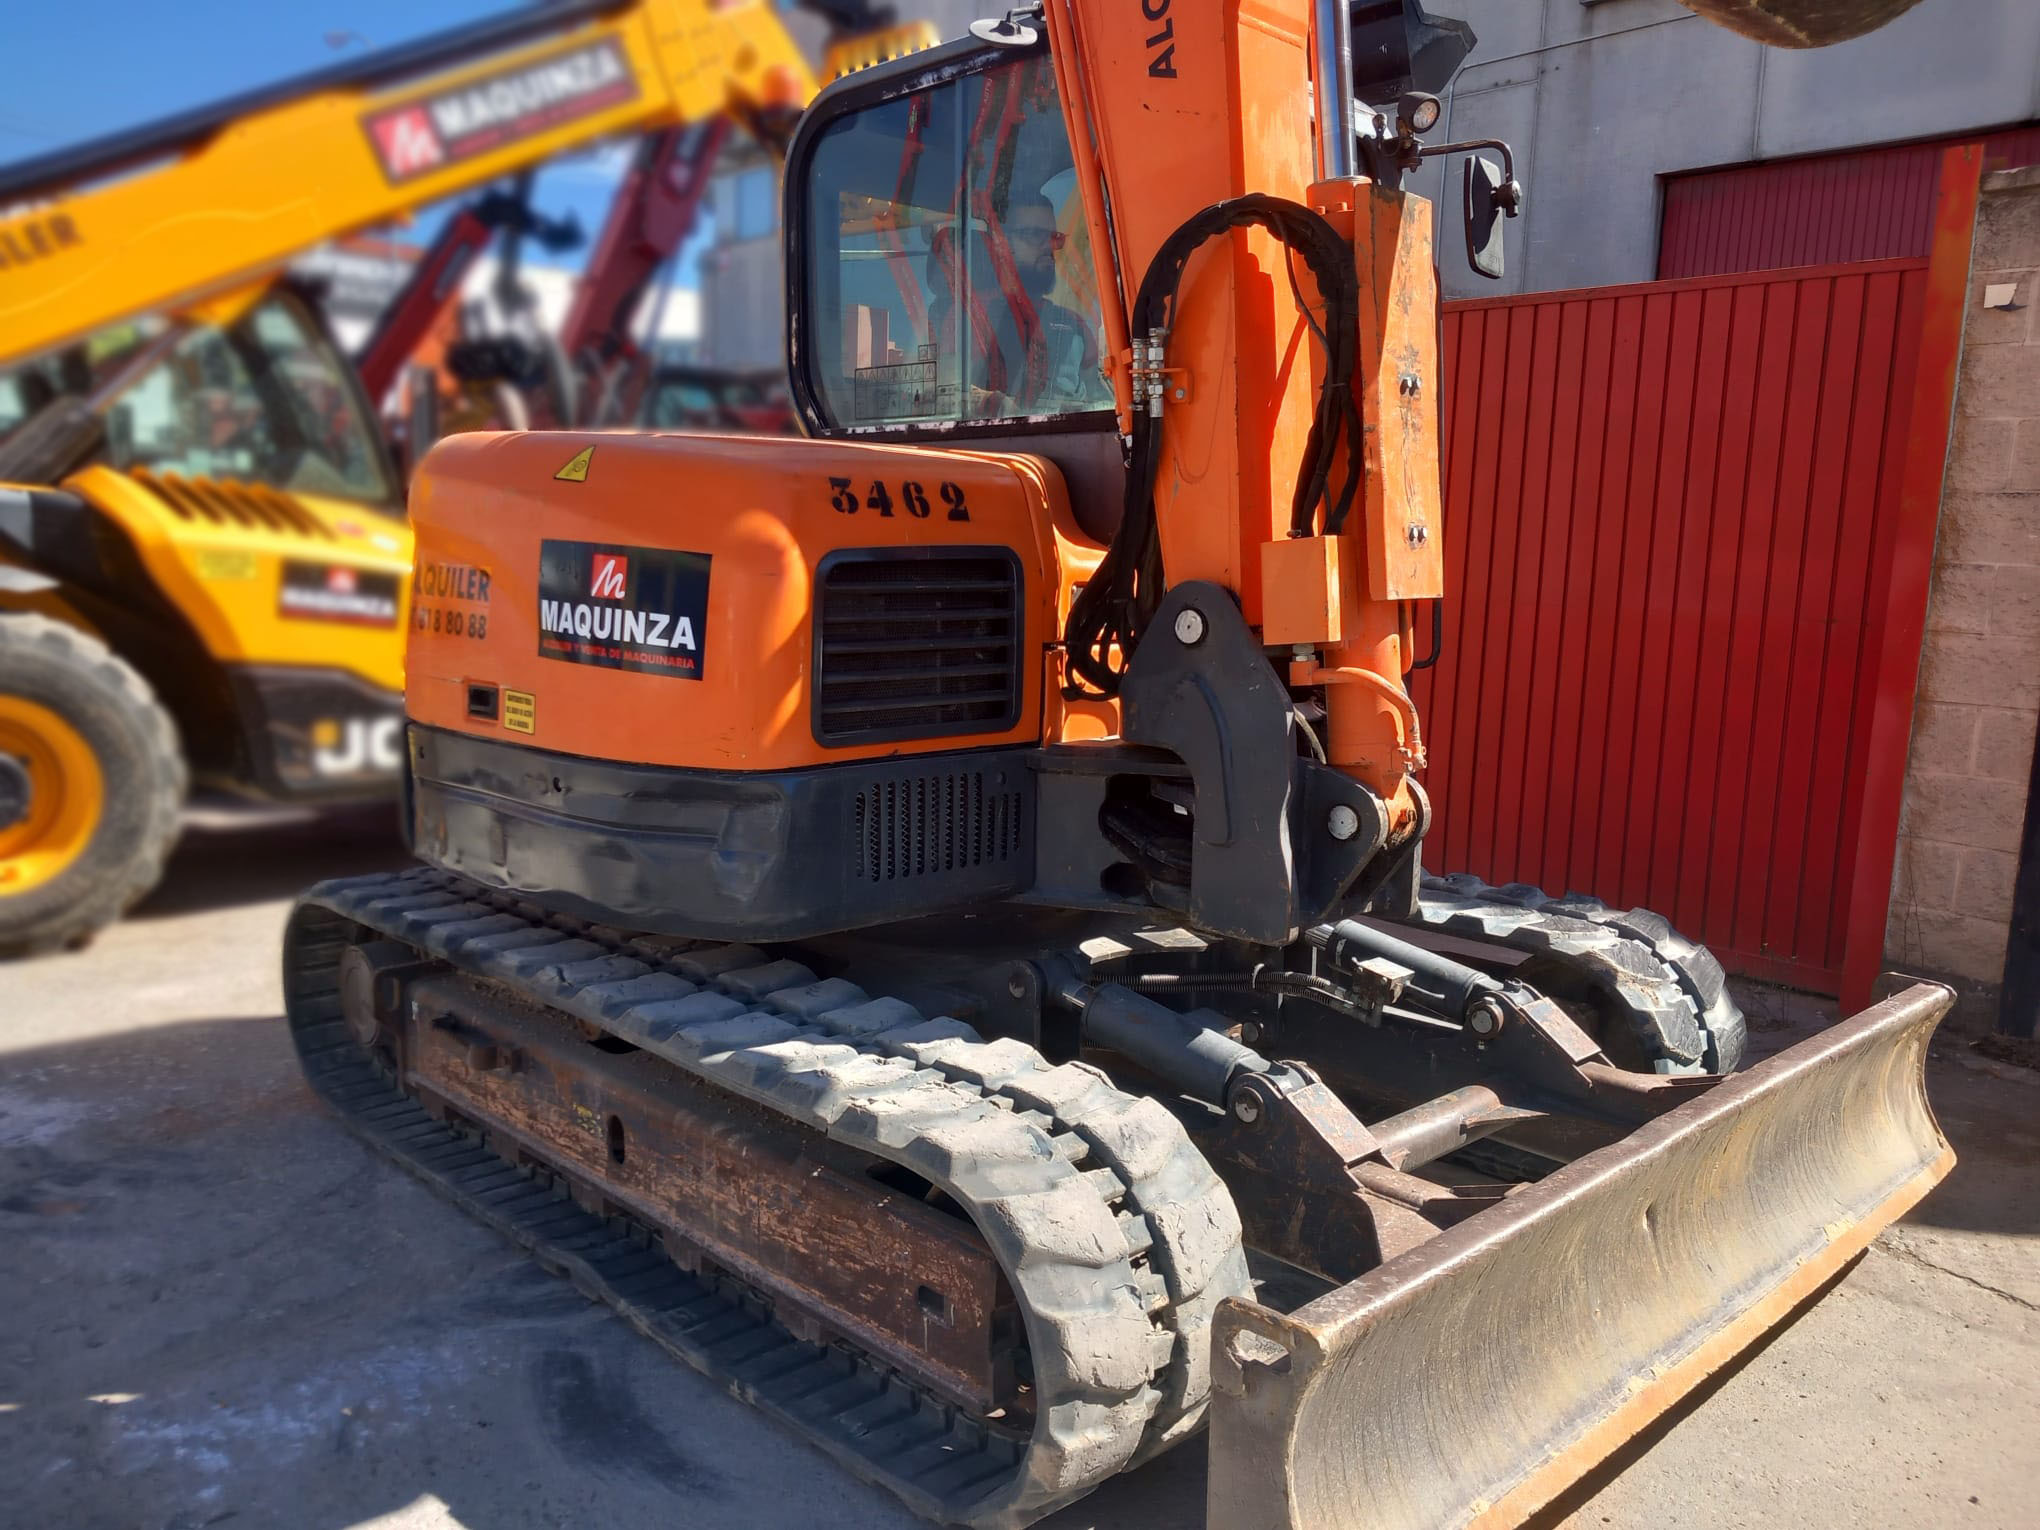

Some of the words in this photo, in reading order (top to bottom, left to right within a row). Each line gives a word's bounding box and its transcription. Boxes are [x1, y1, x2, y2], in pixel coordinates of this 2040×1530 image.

[829, 476, 970, 522] 3462
[541, 599, 697, 650] MAQUINZA
[624, 651, 695, 669] MAQUINARIA
